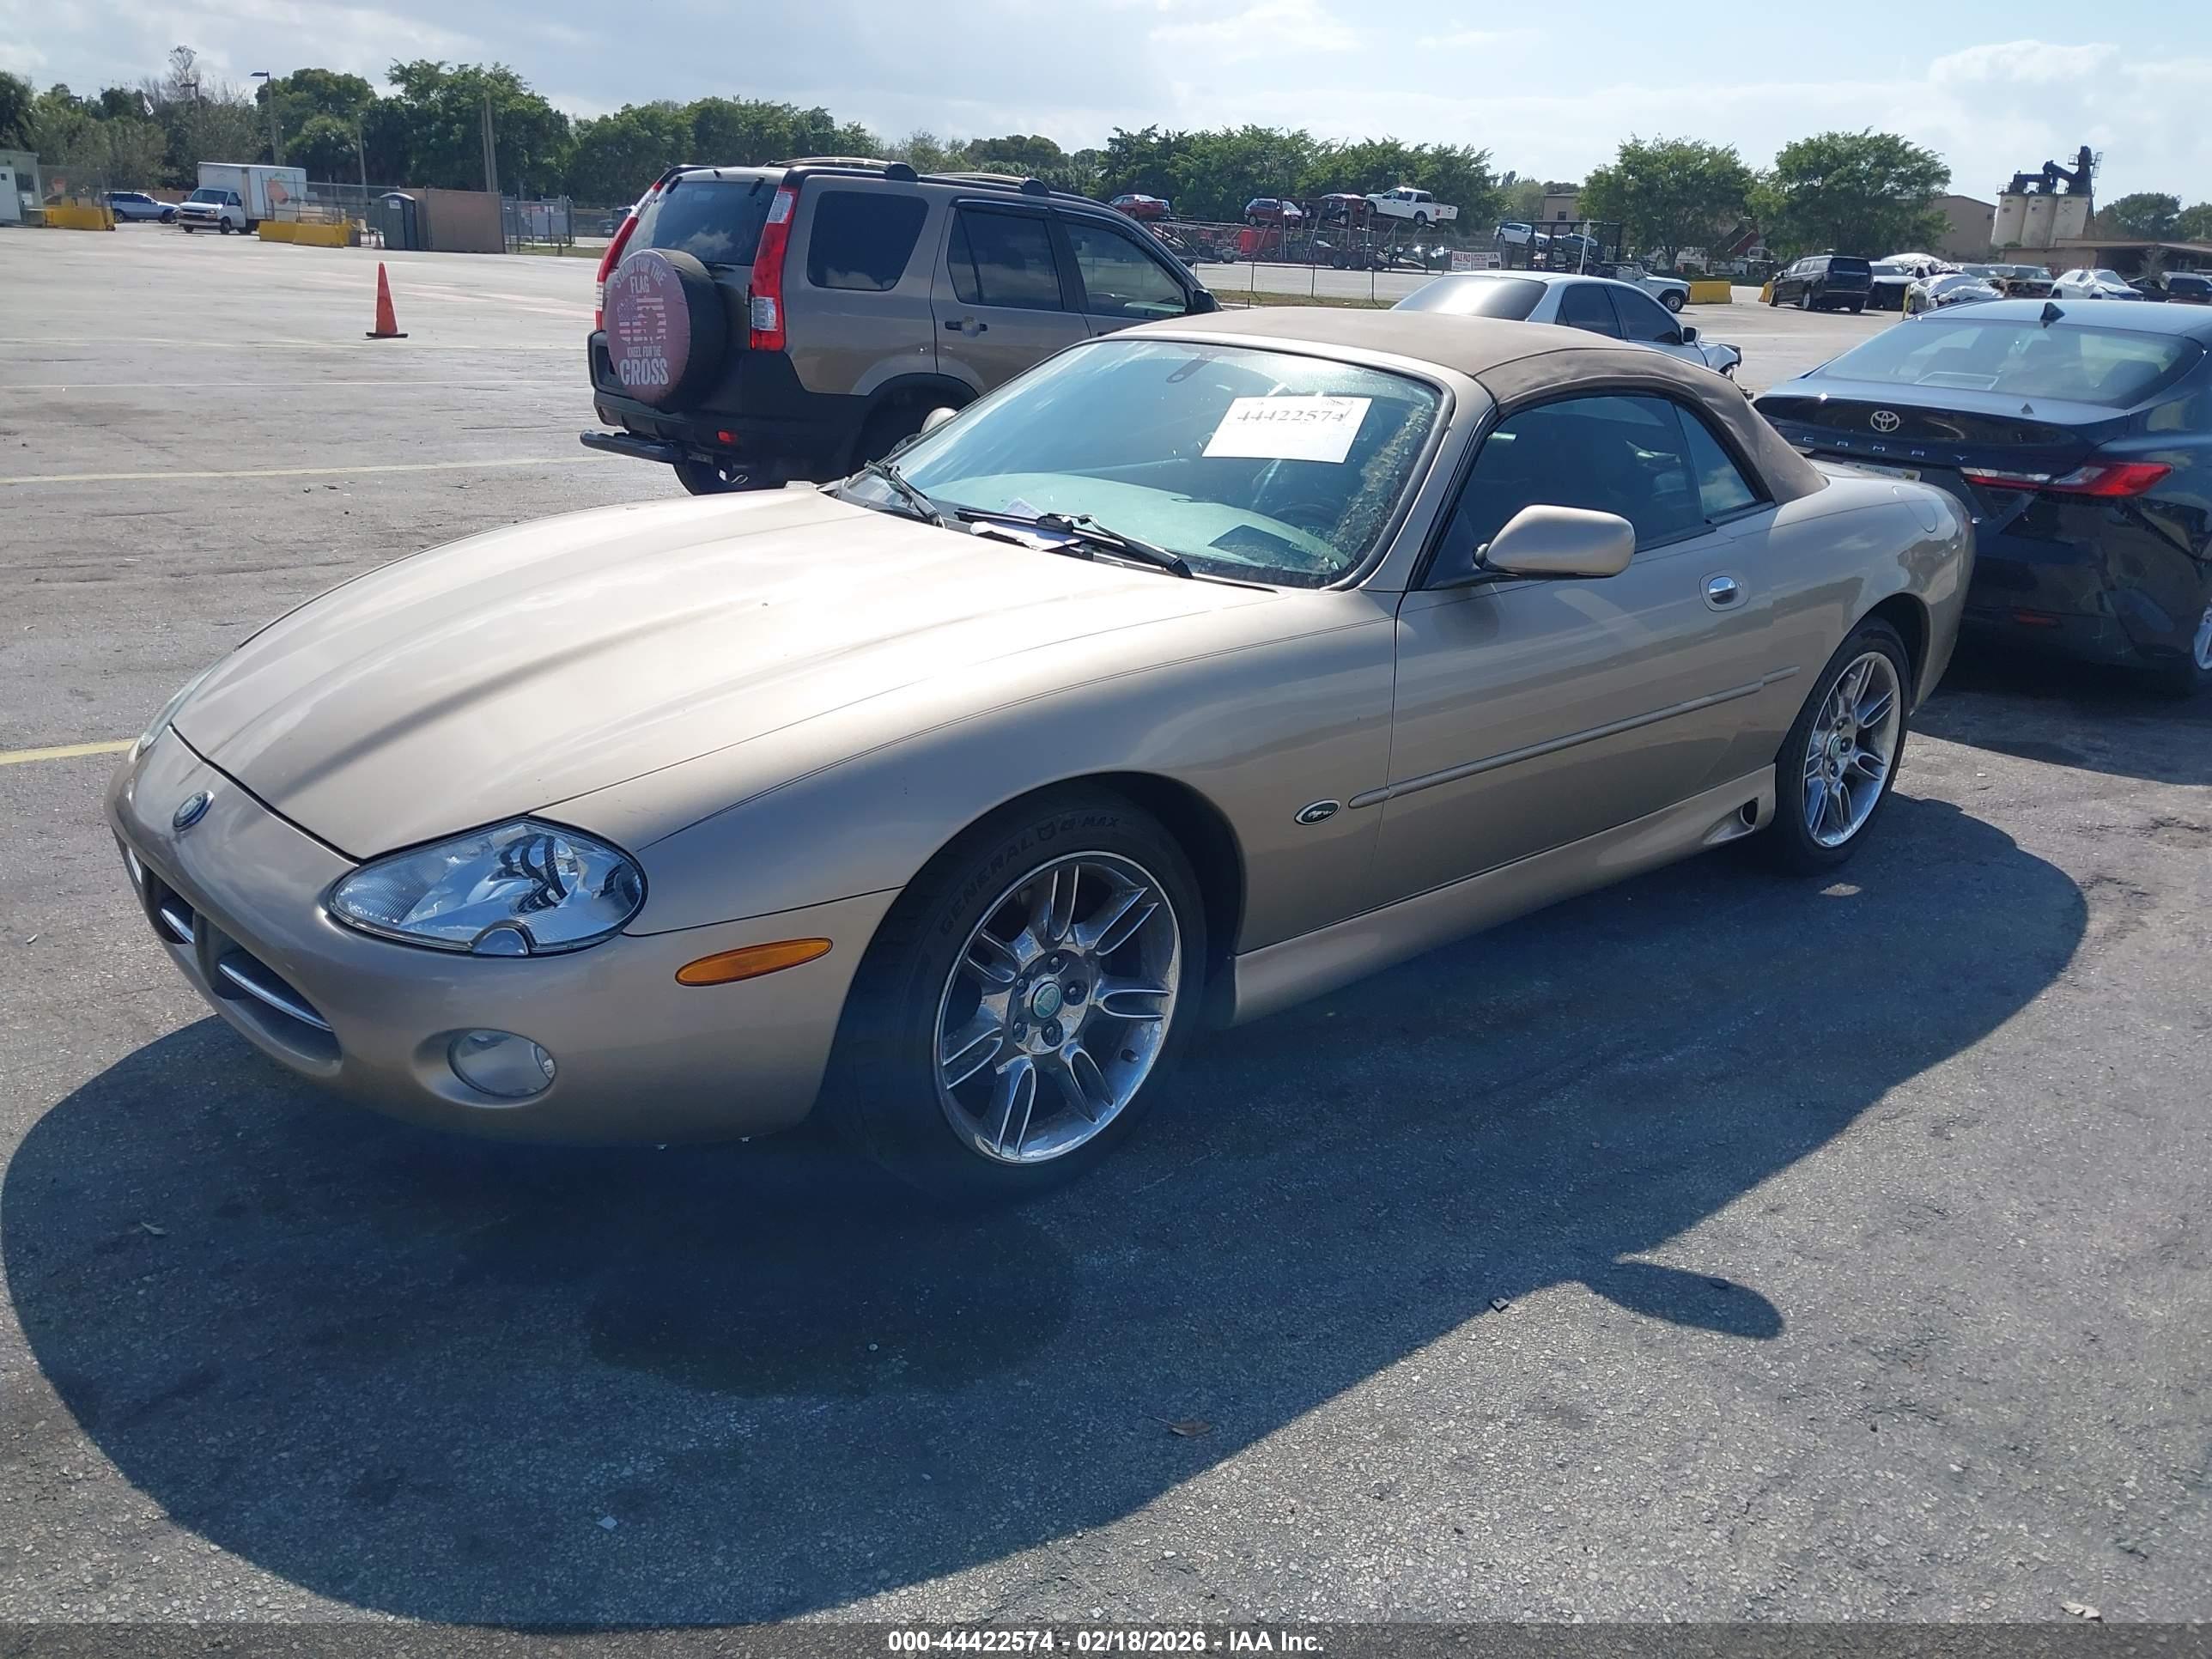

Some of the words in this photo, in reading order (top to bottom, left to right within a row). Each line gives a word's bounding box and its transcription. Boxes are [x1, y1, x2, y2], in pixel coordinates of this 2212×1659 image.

[616, 260, 635, 289] STAND
[636, 258, 650, 273] FOR
[650, 262, 666, 287] THE
[629, 276, 650, 294] FLAG
[627, 346, 642, 358] KNEEL
[642, 346, 653, 357] FOR
[653, 345, 662, 357] THE
[619, 358, 669, 386] CROSS
[1237, 410, 1346, 422] 44422574
